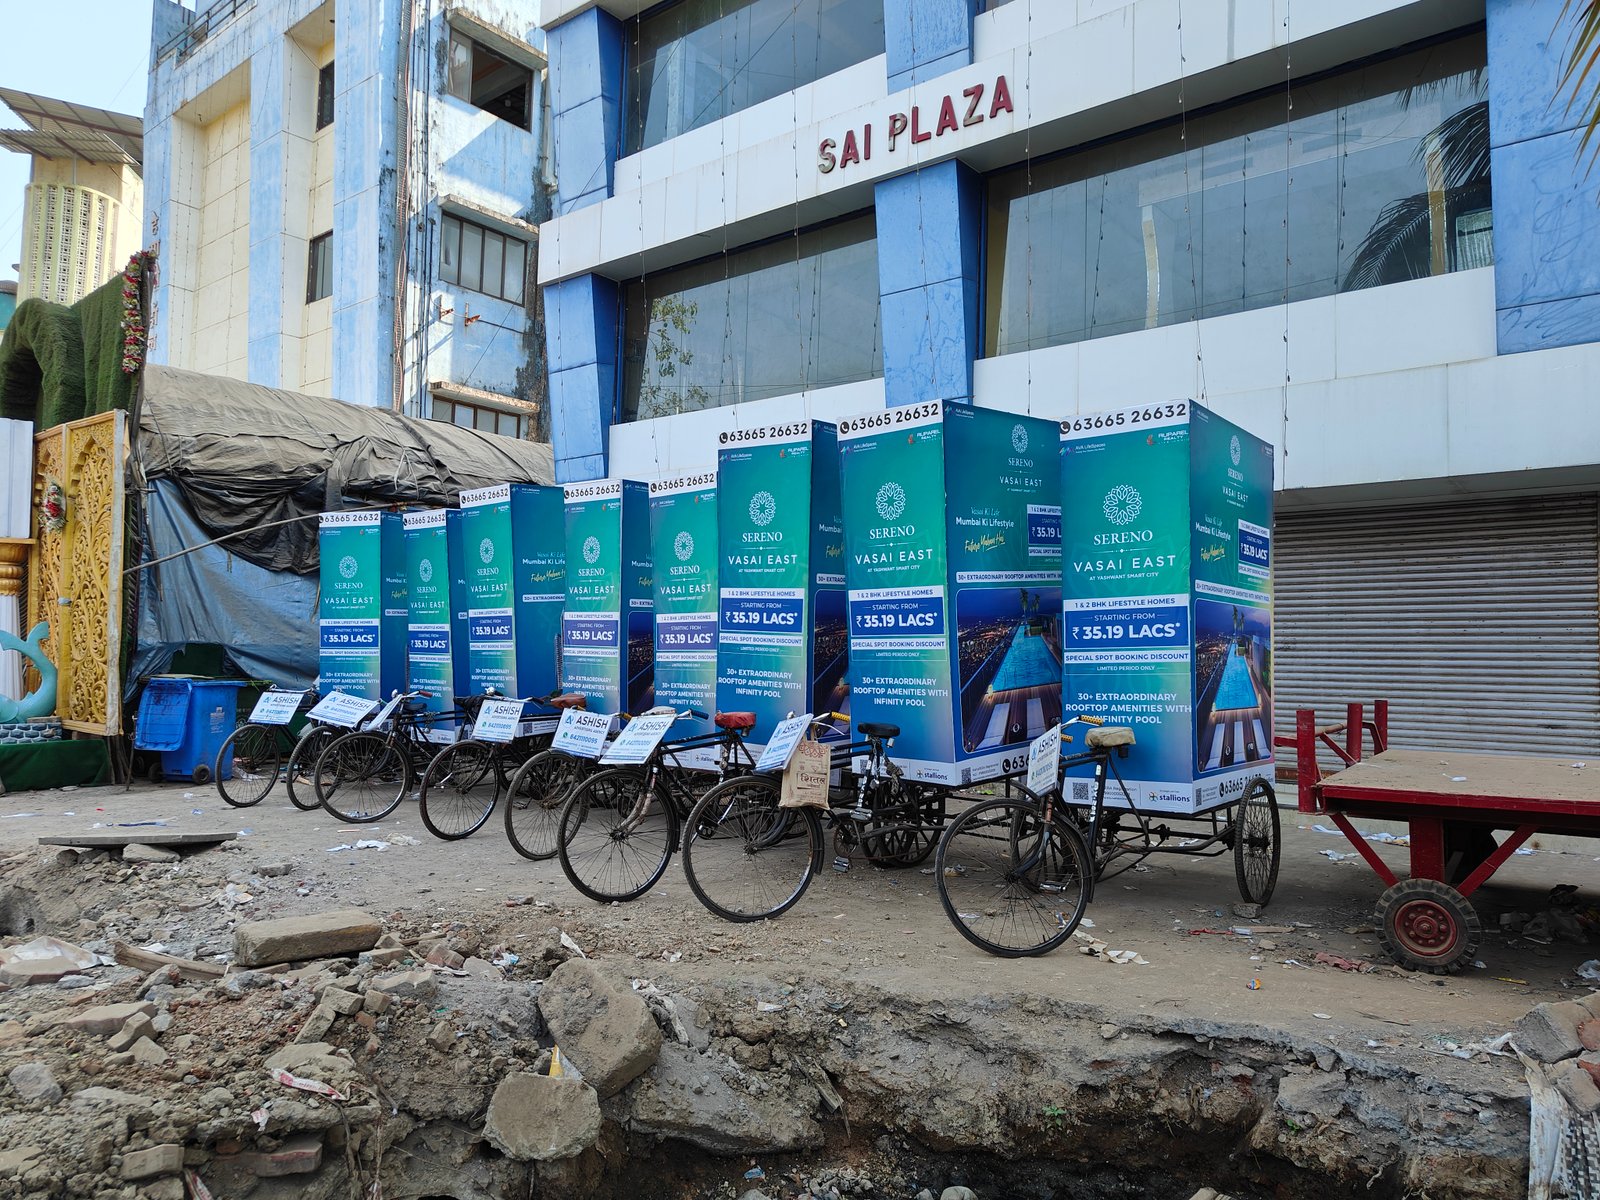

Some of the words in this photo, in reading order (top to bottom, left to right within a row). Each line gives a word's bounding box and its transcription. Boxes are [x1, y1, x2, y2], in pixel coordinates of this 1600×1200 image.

[818, 123, 872, 174] SAI
[888, 75, 1014, 152] PLAZA
[852, 414, 892, 430] 63665
[896, 404, 938, 423] 26632
[1073, 413, 1125, 432] 63665
[1131, 404, 1186, 424] 26632
[730, 428, 766, 442] 63665
[770, 423, 808, 438] 26632
[1008, 458, 1034, 468] SERENO
[658, 478, 684, 491] 63665
[686, 473, 714, 487] 26632
[1000, 476, 1022, 485] VASAI
[1024, 478, 1042, 488] EAST
[466, 490, 486, 502] 63665
[488, 488, 508, 500] 26632
[570, 487, 594, 498] 63665
[596, 484, 620, 495] 26632
[1222, 486, 1236, 496] VASAI
[1237, 492, 1248, 502] EAST
[325, 514, 350, 522] 63665
[352, 513, 378, 522] 26632
[408, 516, 426, 526] 63665
[427, 514, 445, 524] 26632
[956, 517, 981, 526] Mumbai
[982, 518, 988, 527] Ki
[990, 518, 1014, 530] Lifestyle
[742, 532, 782, 542] SERENO
[870, 525, 915, 540] SERENO
[1195, 522, 1211, 535] Mumbai
[1216, 528, 1231, 542] Lifestyle
[1094, 530, 1153, 546] SERENO
[728, 556, 762, 565] VASAI
[768, 554, 798, 564] EAST
[855, 552, 892, 564] VASAI
[900, 549, 933, 562] EAST
[1074, 558, 1122, 572] VASAI
[1132, 554, 1176, 568] EAST
[476, 566, 500, 576] SERENO
[578, 568, 604, 576] SERENO
[670, 565, 700, 576] SERENO
[416, 586, 438, 594] SERENO
[470, 584, 488, 592] VASAI
[492, 583, 508, 592] EAST
[594, 586, 615, 594] EAST
[660, 586, 686, 594] VASAI
[689, 584, 712, 592] EAST
[738, 669, 792, 680] EXTRAORDINARY
[718, 676, 747, 686] ROOFTOP
[748, 680, 782, 688] AMENITIES
[876, 678, 937, 686] EXTRAORDINARY
[736, 688, 762, 697] INFINITY
[886, 688, 926, 696] AMENITIES
[927, 689, 948, 697] WITH
[1078, 692, 1094, 700] 30+
[1095, 693, 1177, 702] EXTRAORDINARY
[272, 696, 300, 705] ASHISH
[340, 699, 371, 709] ASHISH
[874, 698, 904, 706] INFINITY
[906, 699, 926, 707] POOL
[494, 706, 520, 716] ASHISH
[1065, 704, 1109, 712] ROOFTOP
[1110, 704, 1163, 712] AMENITIES
[1165, 704, 1192, 713] WITH
[576, 716, 608, 729] ASHISH
[1135, 716, 1162, 724] POOL
[638, 720, 669, 732] ASHISH
[924, 772, 948, 780] stallions
[1224, 777, 1243, 794] 63665
[1159, 793, 1190, 802] stallions
